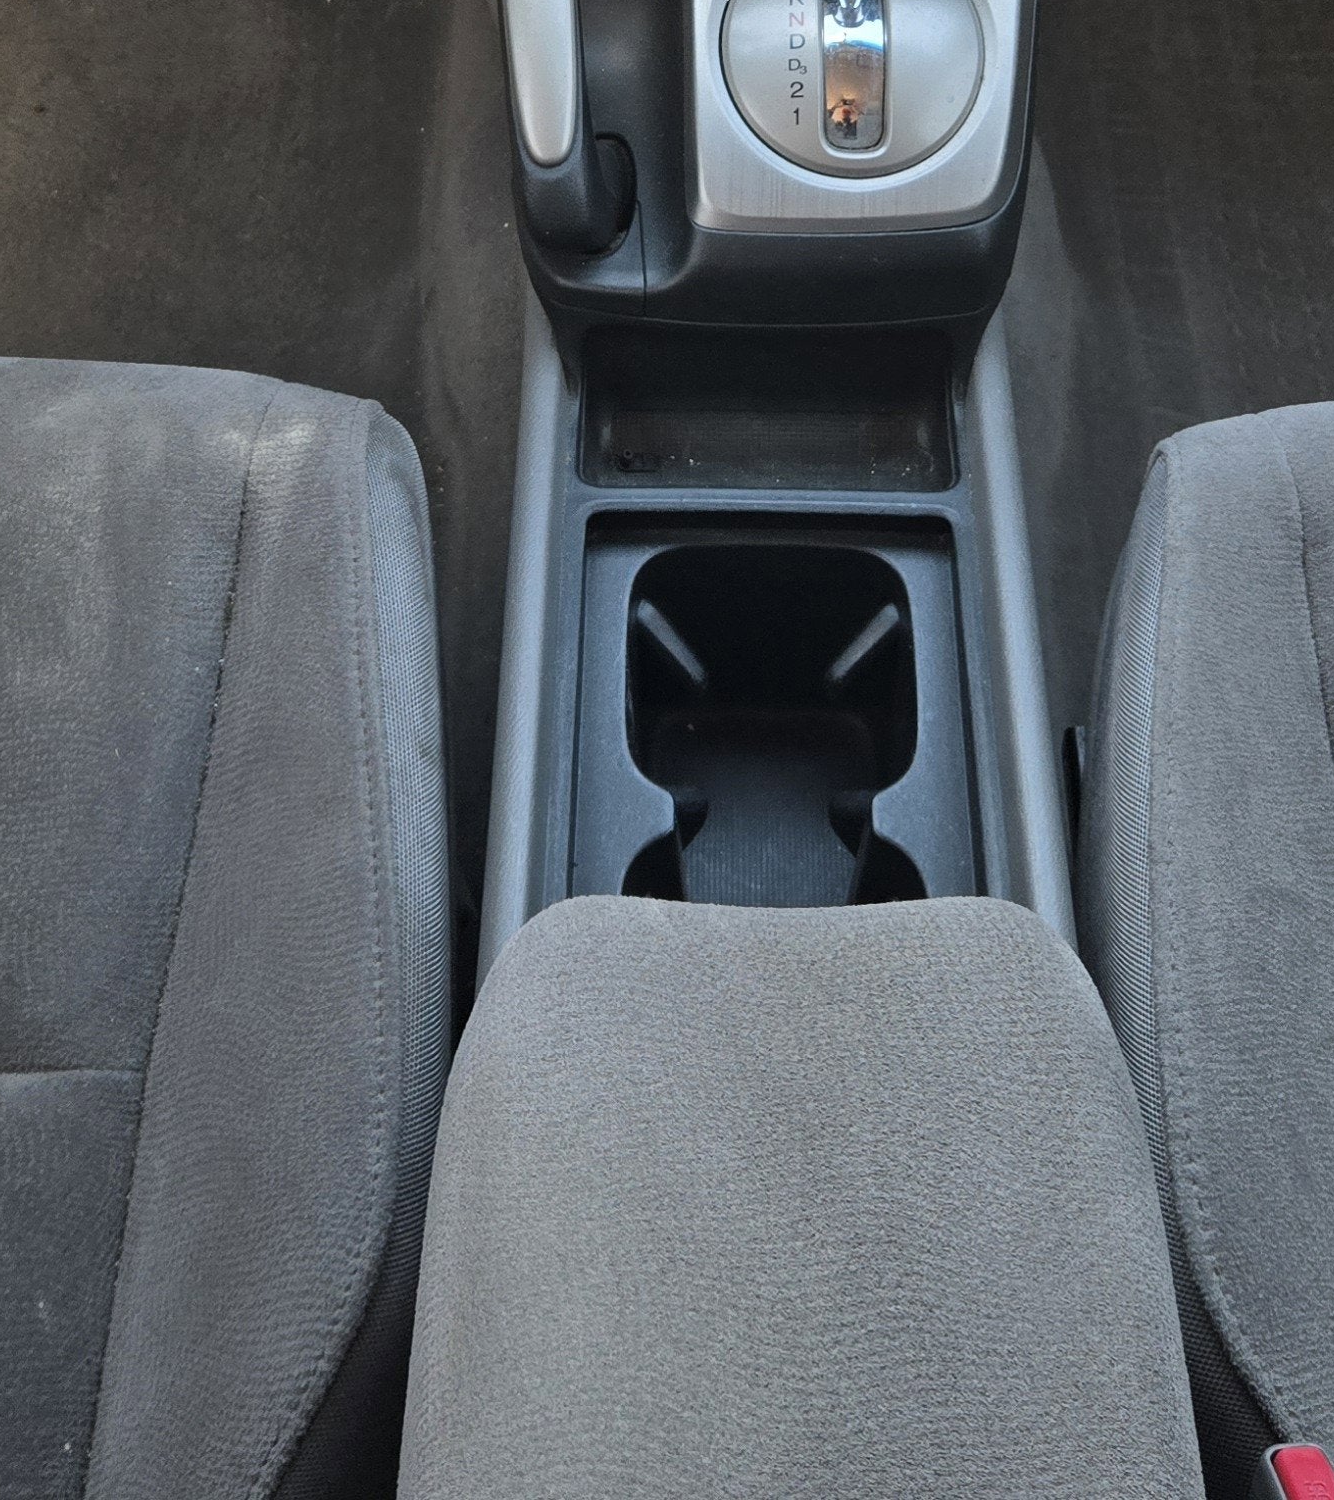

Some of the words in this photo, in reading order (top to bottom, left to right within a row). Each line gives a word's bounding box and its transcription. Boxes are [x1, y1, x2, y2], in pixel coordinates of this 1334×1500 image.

[788, 11, 805, 27] N
[789, 33, 806, 50] D
[787, 58, 808, 76] D3
[789, 81, 805, 99] 2
[792, 107, 801, 126] 1
